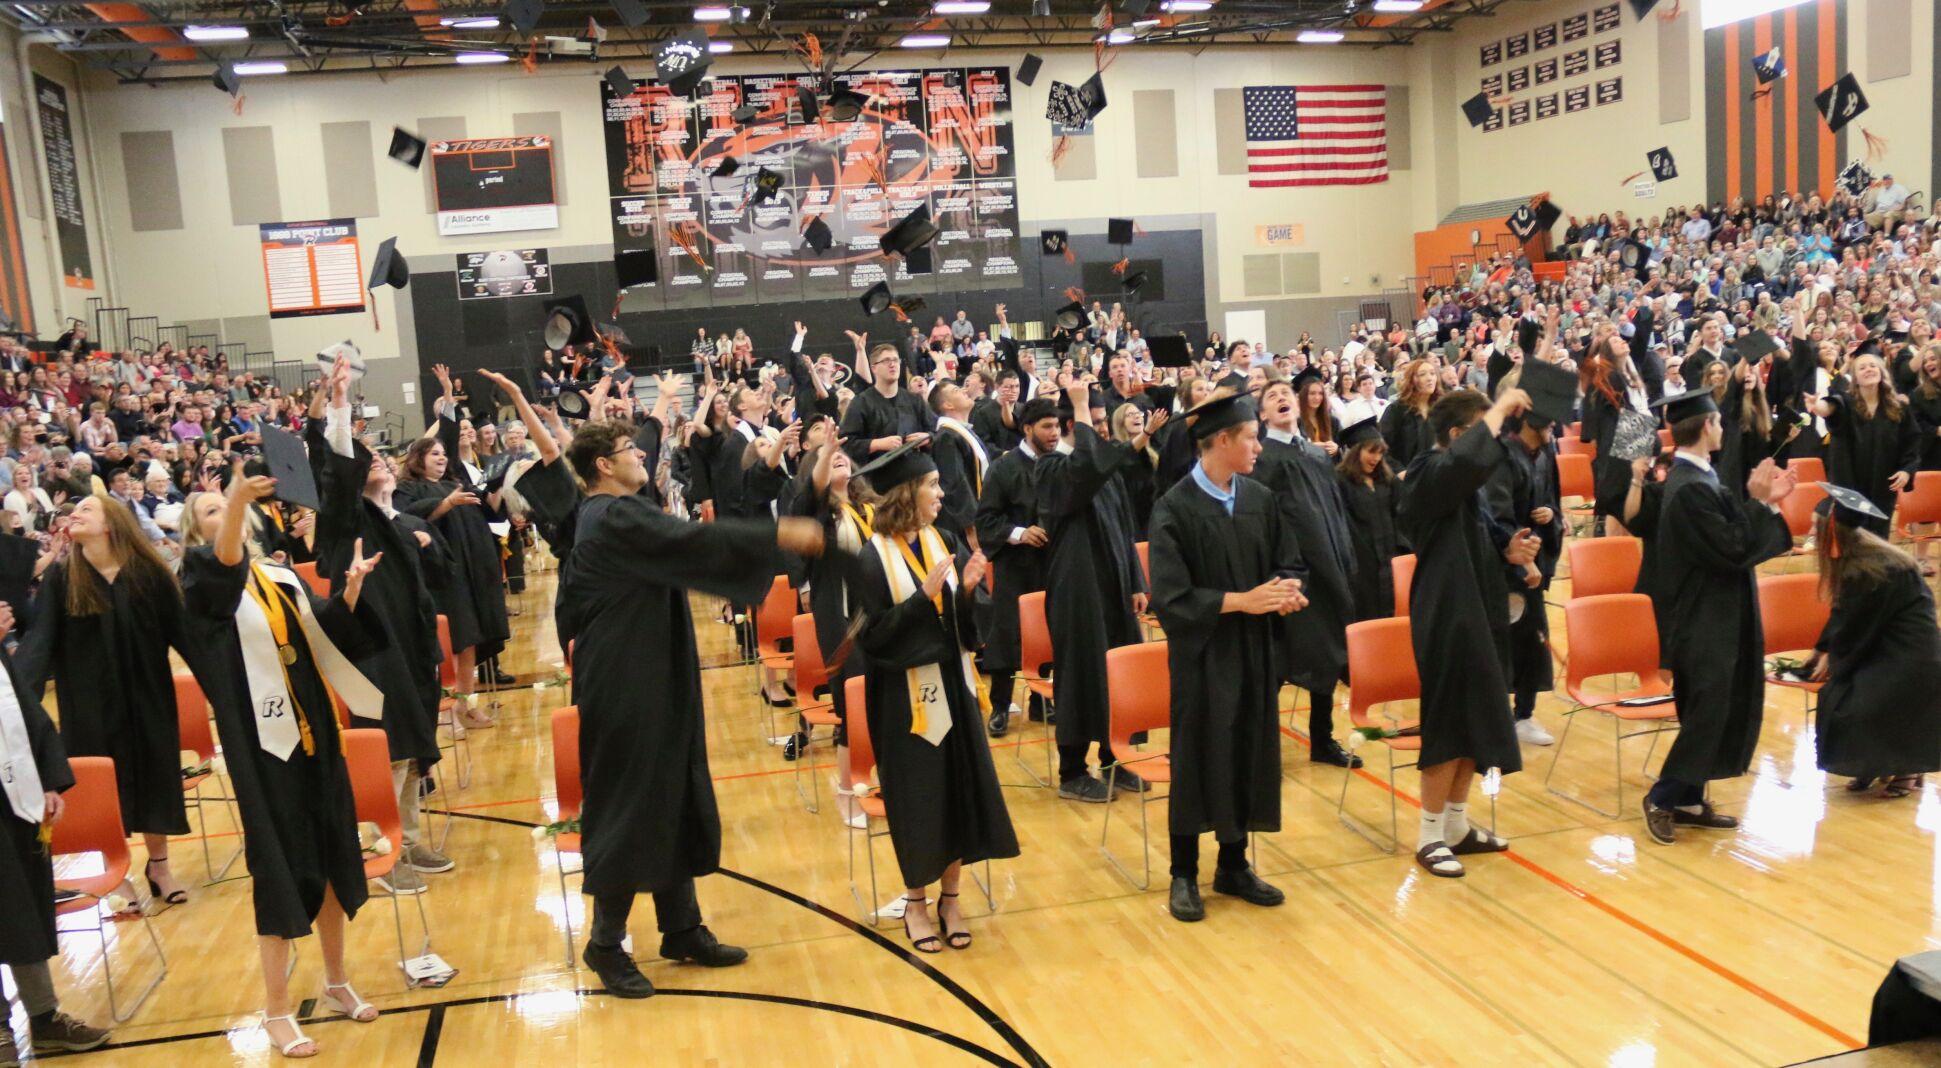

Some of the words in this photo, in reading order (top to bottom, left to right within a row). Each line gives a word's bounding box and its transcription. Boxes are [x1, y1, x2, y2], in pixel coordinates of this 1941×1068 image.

[451, 138, 529, 151] TIGERS
[451, 214, 490, 224] Alliance
[323, 226, 349, 237] CLUB
[1267, 228, 1293, 241] GAME
[920, 682, 938, 703] R
[262, 695, 284, 718] R
